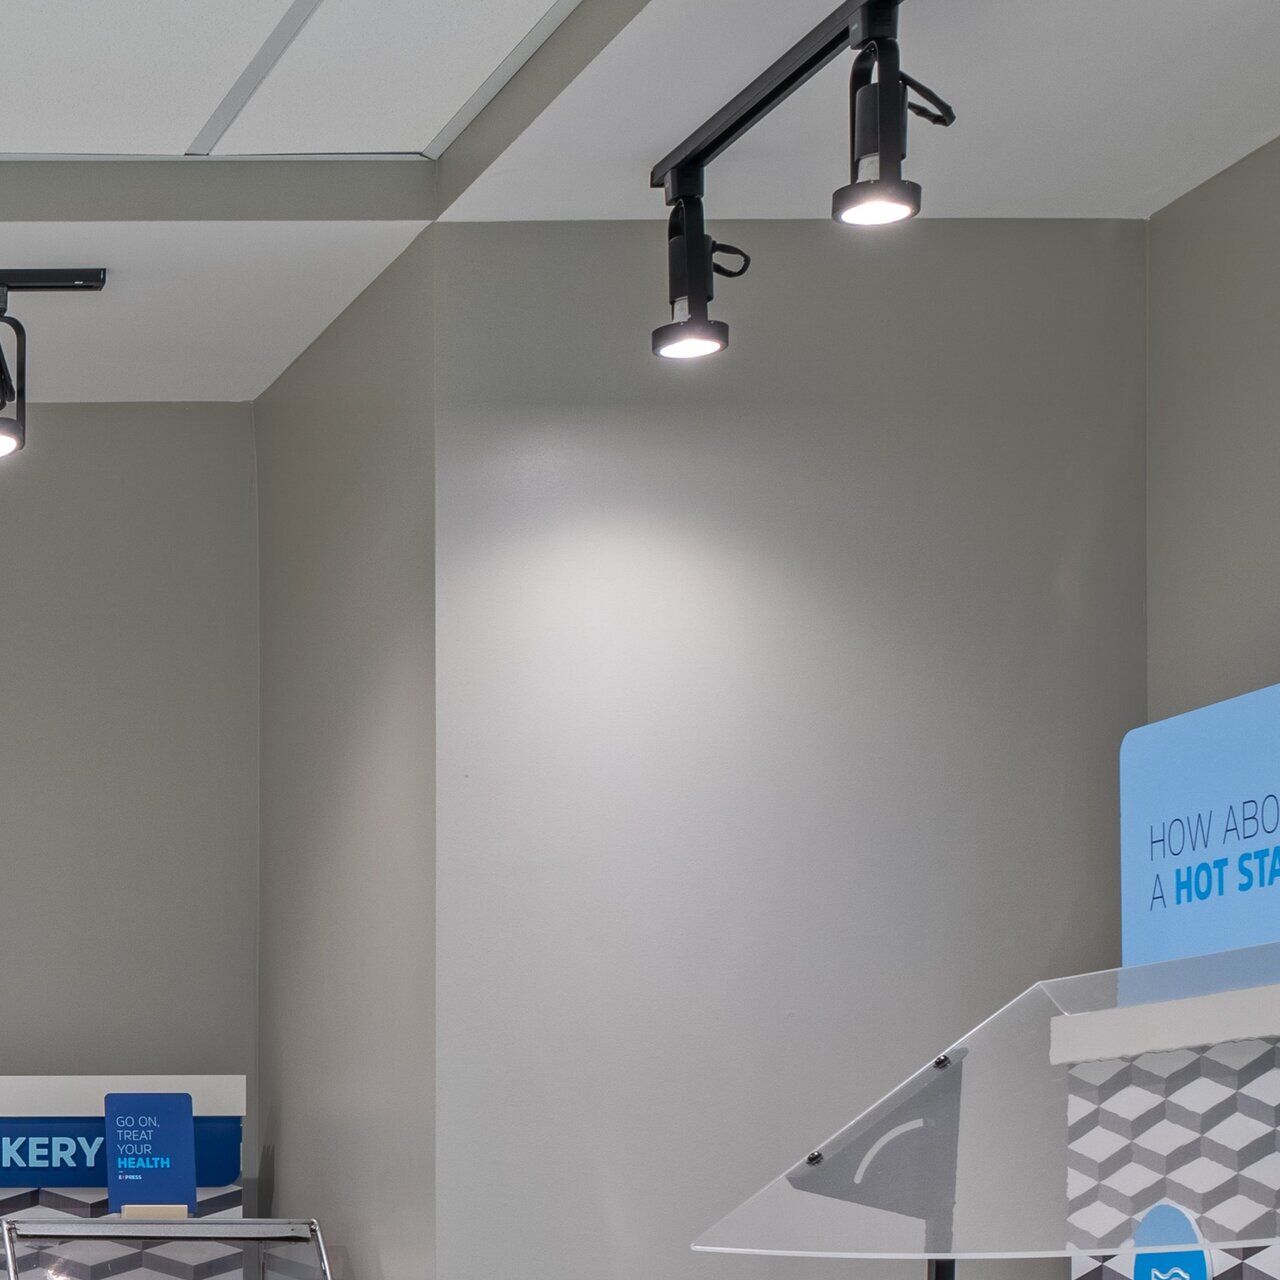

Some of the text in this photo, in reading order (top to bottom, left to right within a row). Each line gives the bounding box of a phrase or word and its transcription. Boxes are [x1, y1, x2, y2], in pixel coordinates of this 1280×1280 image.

[1150, 810, 1213, 861] HOW
[1150, 873, 1167, 911] A
[1175, 857, 1228, 905] HOT
[116, 1116, 160, 1128] GO ON,
[116, 1130, 154, 1141] TREAT
[117, 1144, 152, 1154] YOUR
[117, 1157, 171, 1169] HEALTH
